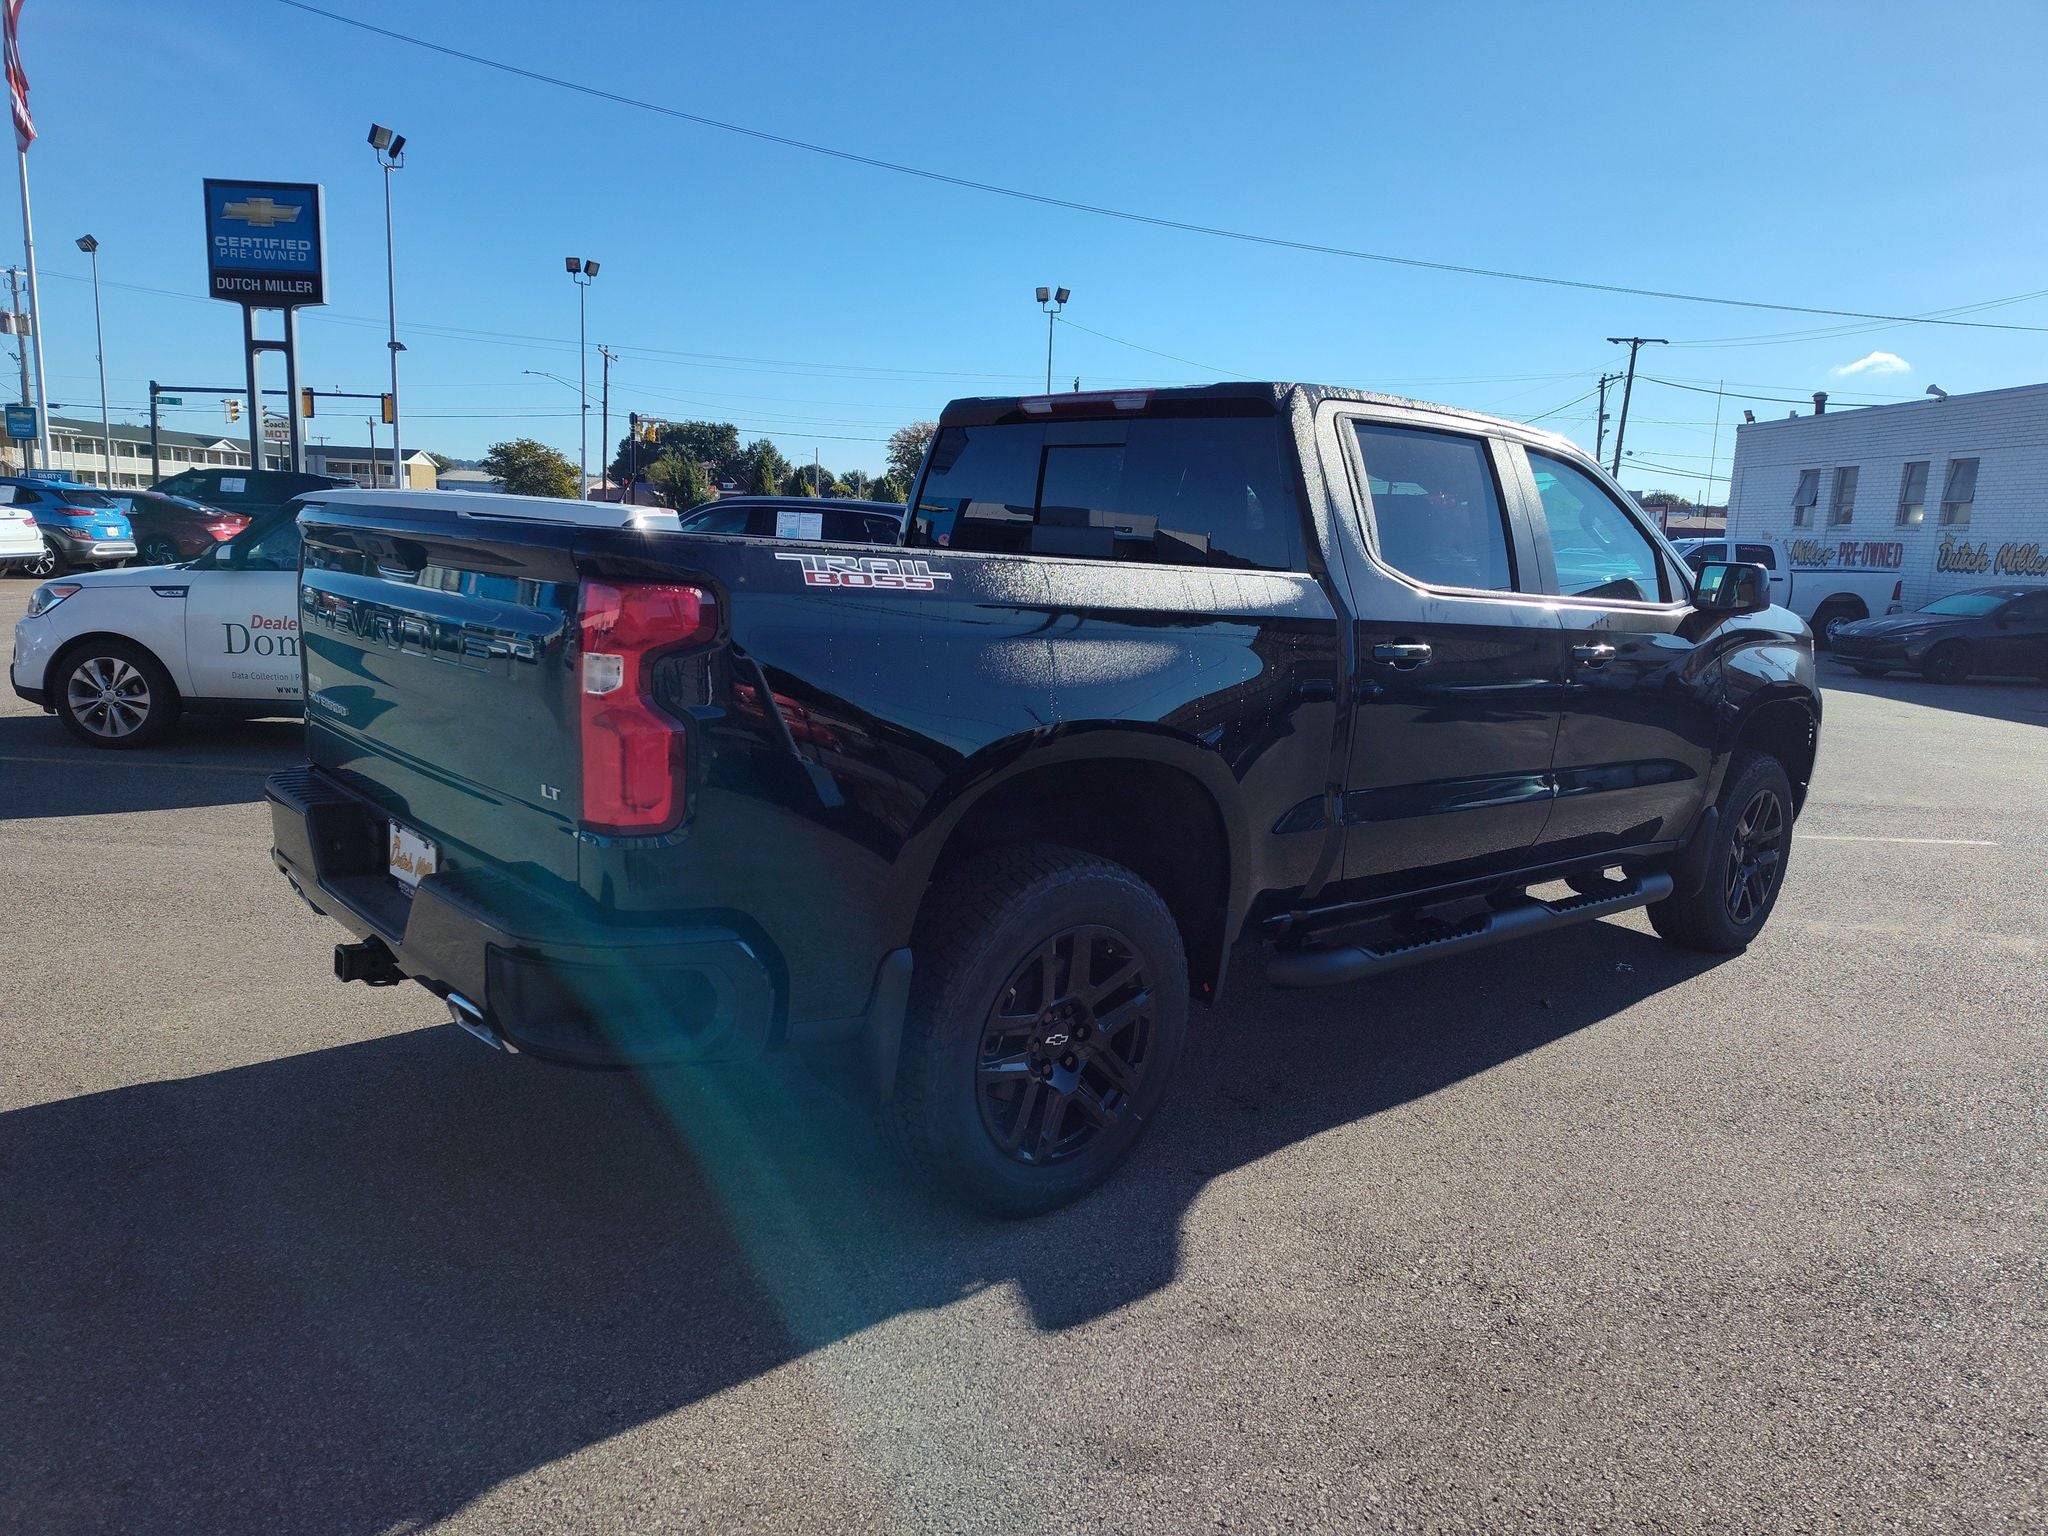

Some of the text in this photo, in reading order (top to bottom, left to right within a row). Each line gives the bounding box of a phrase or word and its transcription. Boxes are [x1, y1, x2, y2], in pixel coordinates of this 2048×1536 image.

[214, 235, 311, 250] CERTIFIED
[220, 247, 307, 262] PRE-OWNED
[216, 276, 313, 294] DUTCH MILLER
[1790, 539, 1836, 568] Miller
[1837, 541, 1904, 569] PRE-OWNED
[1936, 541, 1992, 574] Dutch
[774, 552, 953, 581] TRAIL
[804, 570, 935, 592] BOSS
[231, 671, 249, 680] Data
[250, 671, 289, 681] Collection
[540, 783, 561, 801] LT
